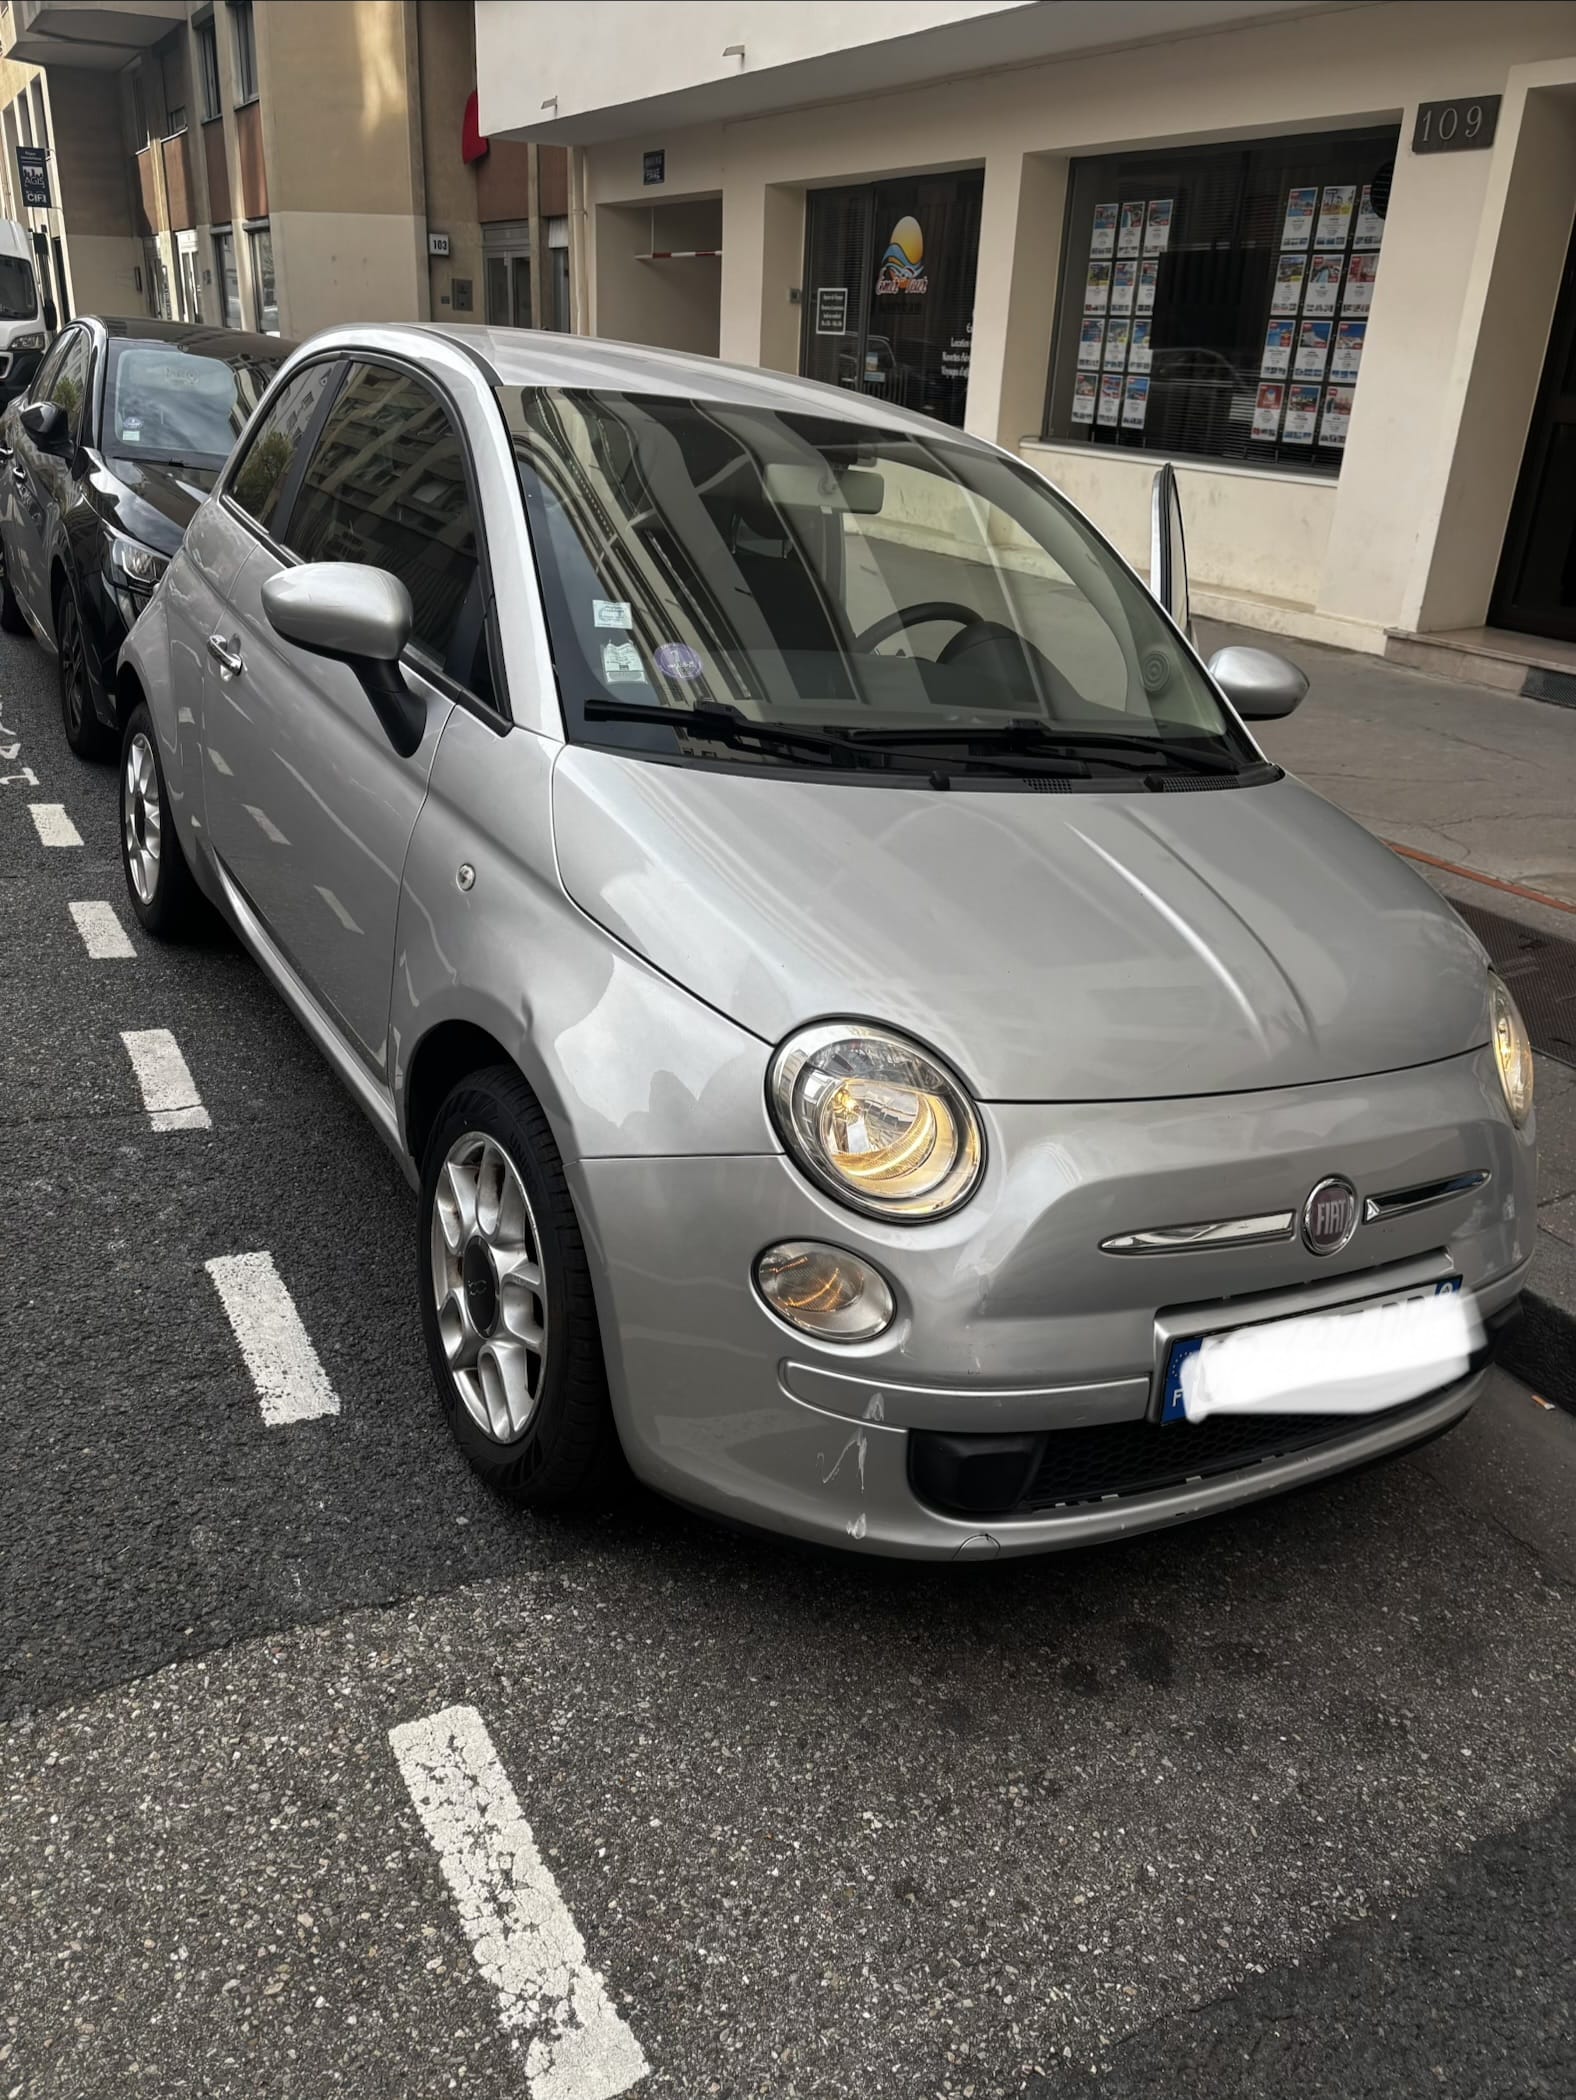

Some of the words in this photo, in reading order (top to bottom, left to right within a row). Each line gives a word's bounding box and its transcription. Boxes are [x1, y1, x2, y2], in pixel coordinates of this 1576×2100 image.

[1423, 105, 1482, 142] 109
[433, 239, 448, 250] 103
[1316, 1199, 1347, 1236] FIAT
